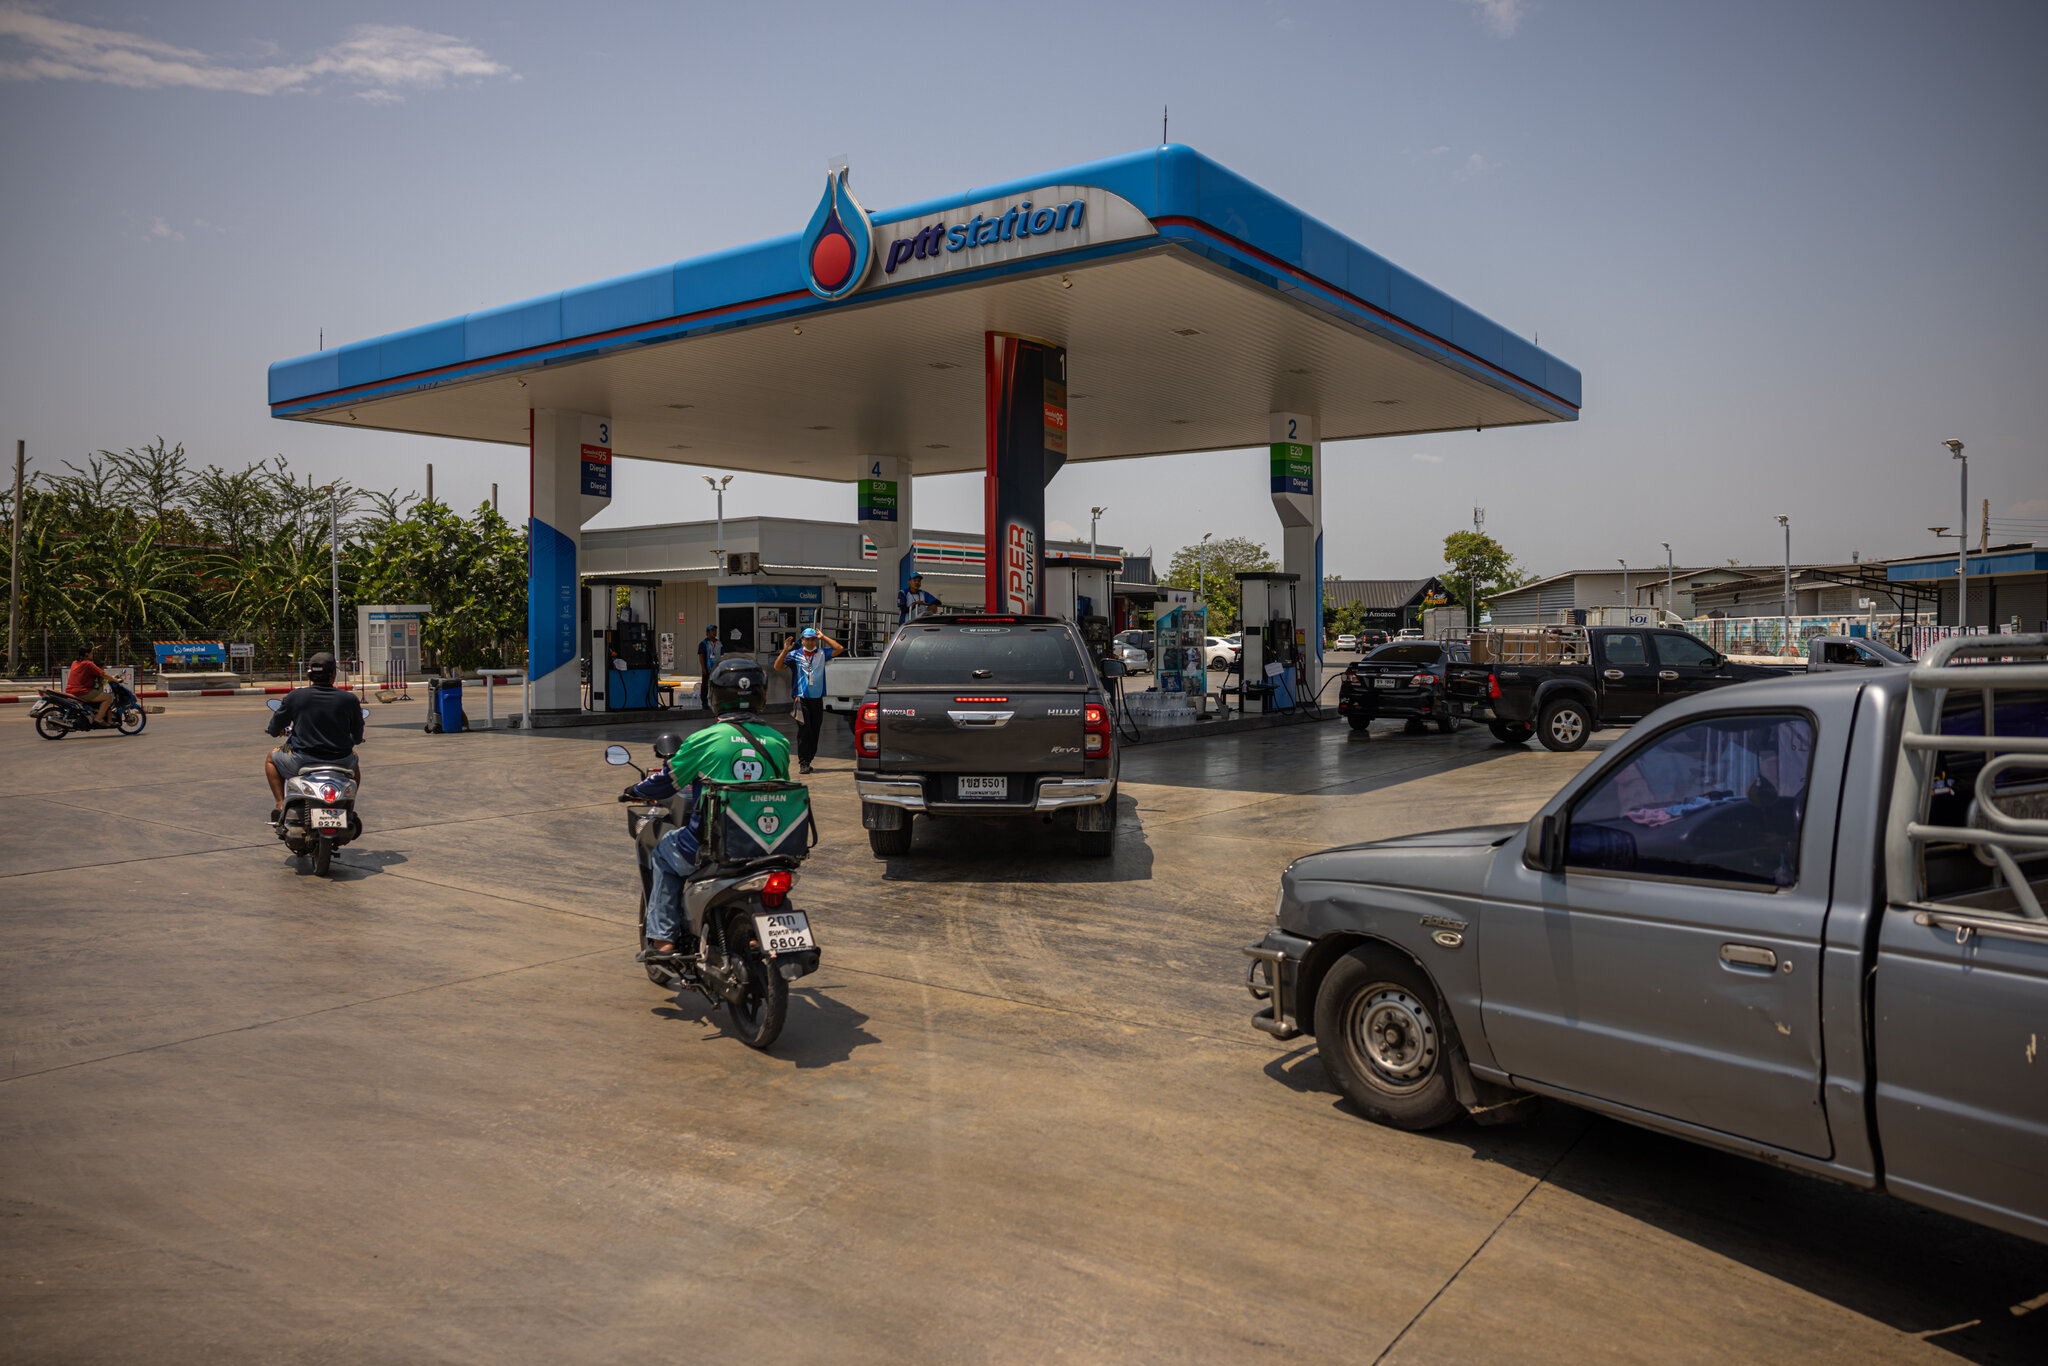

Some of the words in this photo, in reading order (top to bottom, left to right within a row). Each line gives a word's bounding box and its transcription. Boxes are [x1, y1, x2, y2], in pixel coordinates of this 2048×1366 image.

[885, 221, 946, 274] ptt
[945, 199, 1086, 253] station
[1059, 353, 1065, 381] 1
[600, 423, 608, 443] 3
[1288, 419, 1297, 440] 2
[599, 450, 607, 461] 95
[1289, 445, 1303, 456] E20
[590, 463, 607, 473] Diesel
[872, 460, 881, 478] 4
[1303, 464, 1311, 475] 91
[590, 481, 607, 491] Diesel
[872, 481, 887, 490] E20
[1293, 477, 1309, 488] Diesel
[887, 497, 895, 506] 91
[872, 508, 888, 516] Diesel
[1009, 523, 1025, 616] UPER
[1026, 529, 1034, 601] POWER
[799, 591, 818, 600] Cashier
[882, 708, 906, 717] TOYOTA
[1047, 708, 1081, 717] HILUX
[981, 778, 1005, 788] 5501
[770, 936, 806, 949] 6802
